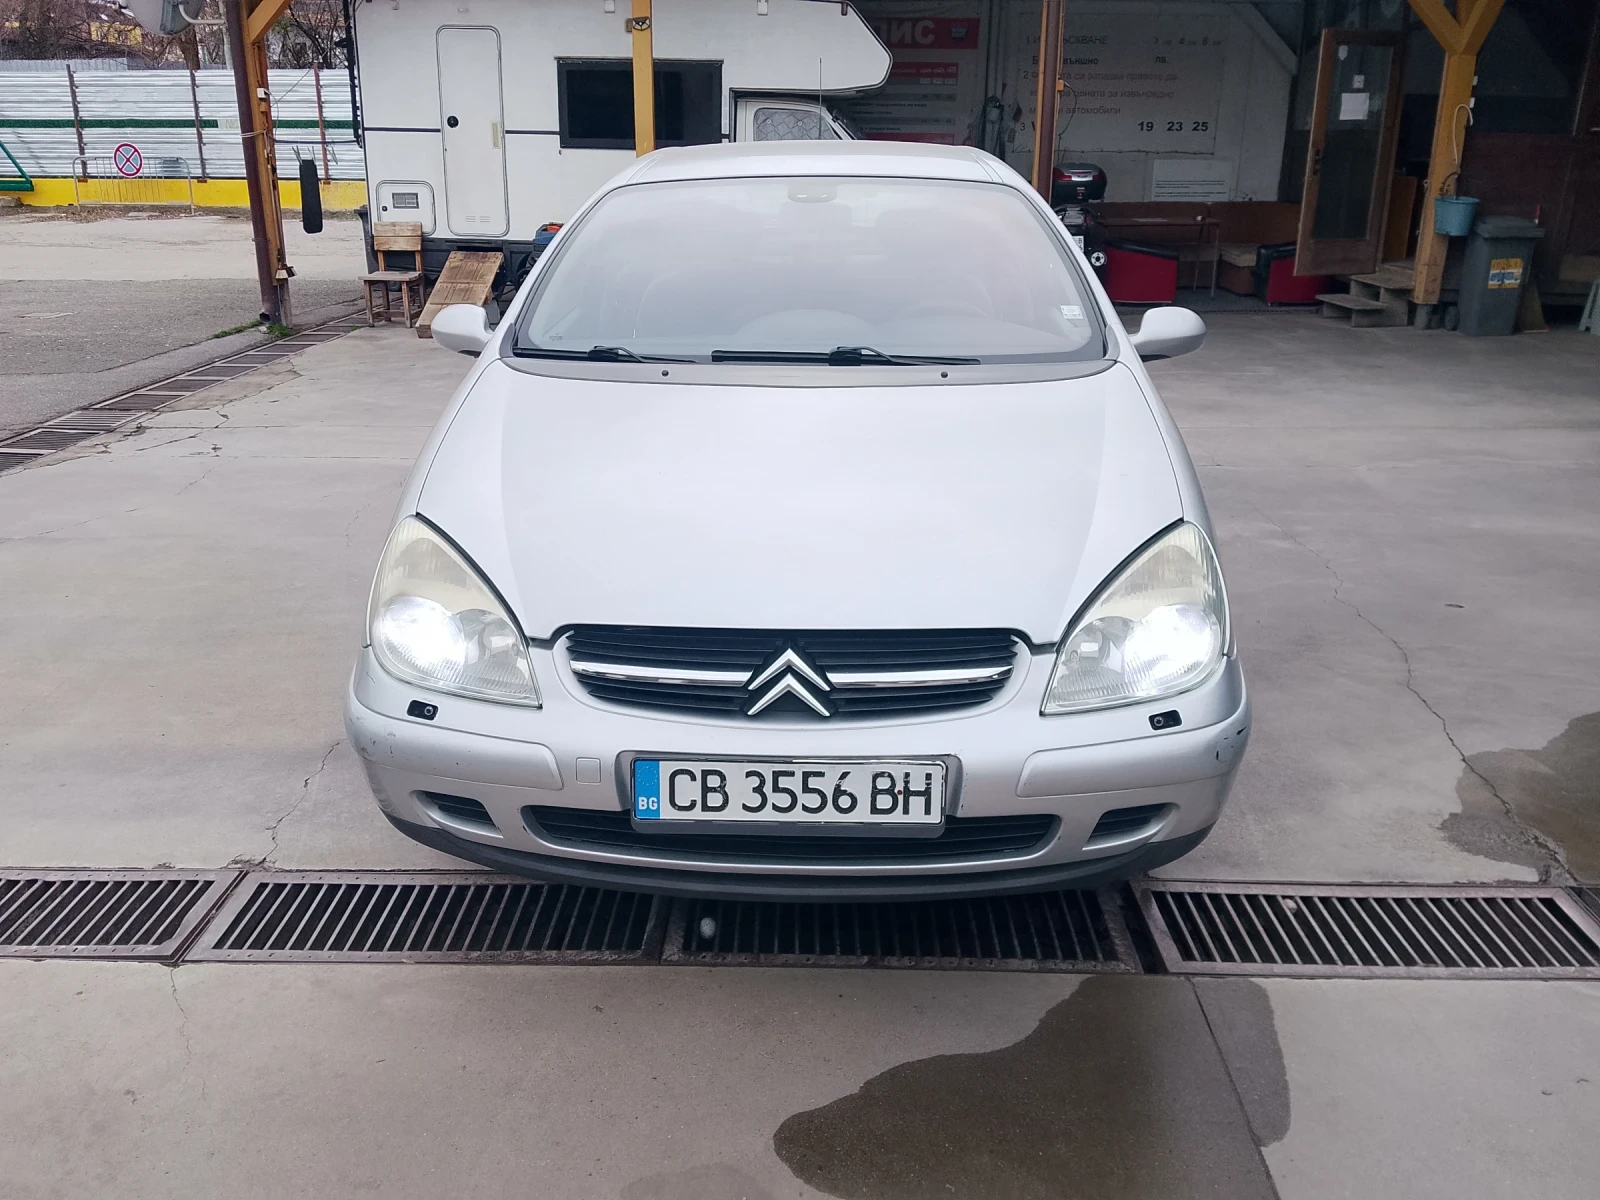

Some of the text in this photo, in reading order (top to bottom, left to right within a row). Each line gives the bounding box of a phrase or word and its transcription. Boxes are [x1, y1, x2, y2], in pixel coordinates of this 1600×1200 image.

[1137, 121, 1155, 132] 19
[1166, 121, 1184, 132] 23
[1191, 121, 1209, 132] 25
[638, 797, 658, 811] BG
[741, 769, 858, 815] 3556
